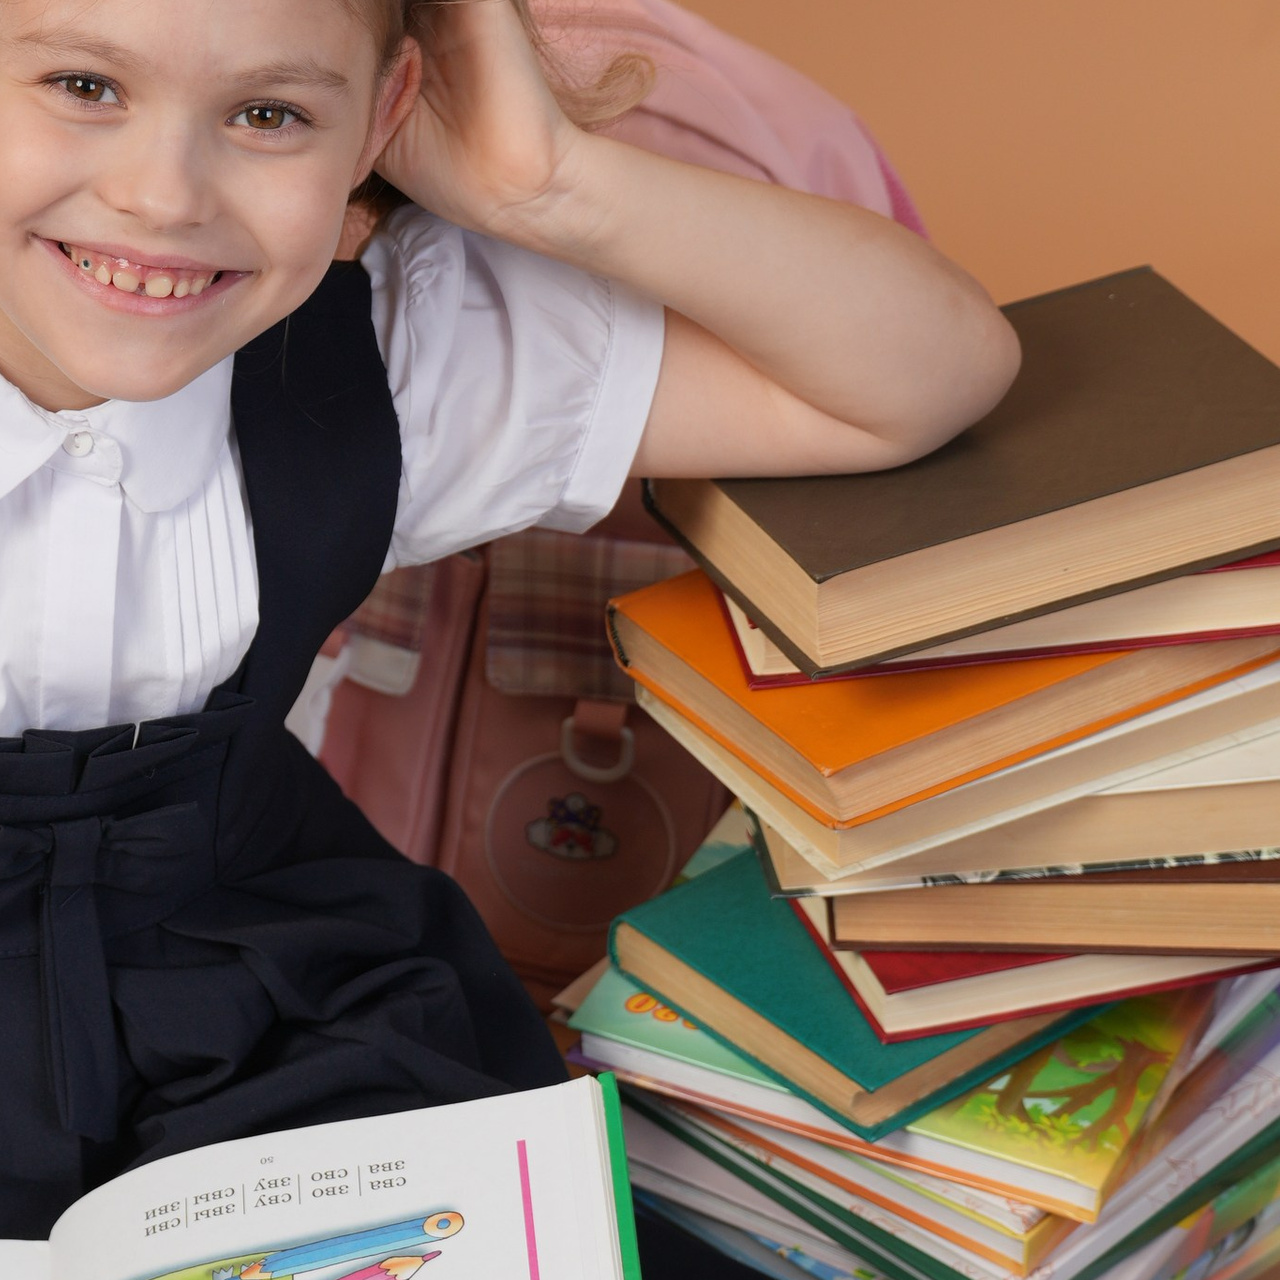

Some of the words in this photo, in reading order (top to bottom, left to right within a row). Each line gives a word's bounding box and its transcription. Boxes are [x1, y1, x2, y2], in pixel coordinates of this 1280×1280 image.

[368, 1160, 405, 1174] зва
[311, 1169, 348, 1182] сво
[254, 1177, 291, 1192] зву
[369, 1177, 406, 1190] сва
[194, 1188, 235, 1205] свы
[312, 1185, 349, 1198] зво
[254, 1193, 292, 1208] сву
[145, 1201, 180, 1220] зви
[194, 1203, 235, 1221] звы
[145, 1218, 181, 1236] сви
